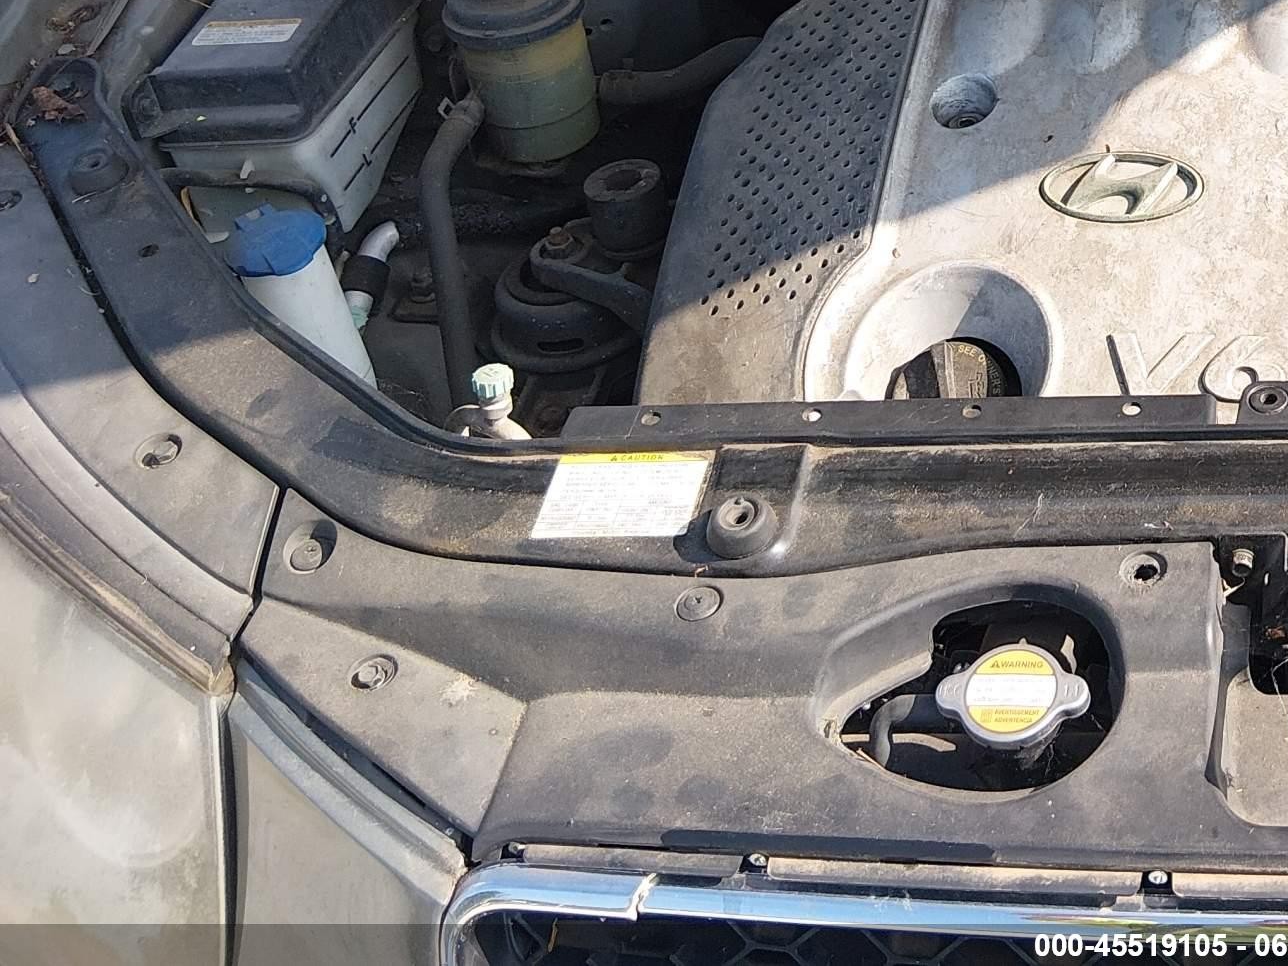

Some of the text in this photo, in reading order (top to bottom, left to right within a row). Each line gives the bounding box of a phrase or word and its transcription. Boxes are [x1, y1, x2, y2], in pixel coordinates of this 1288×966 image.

[1106, 333, 1286, 403] V6
[620, 454, 664, 462] CAUTION
[1000, 660, 1044, 669] WARNING
